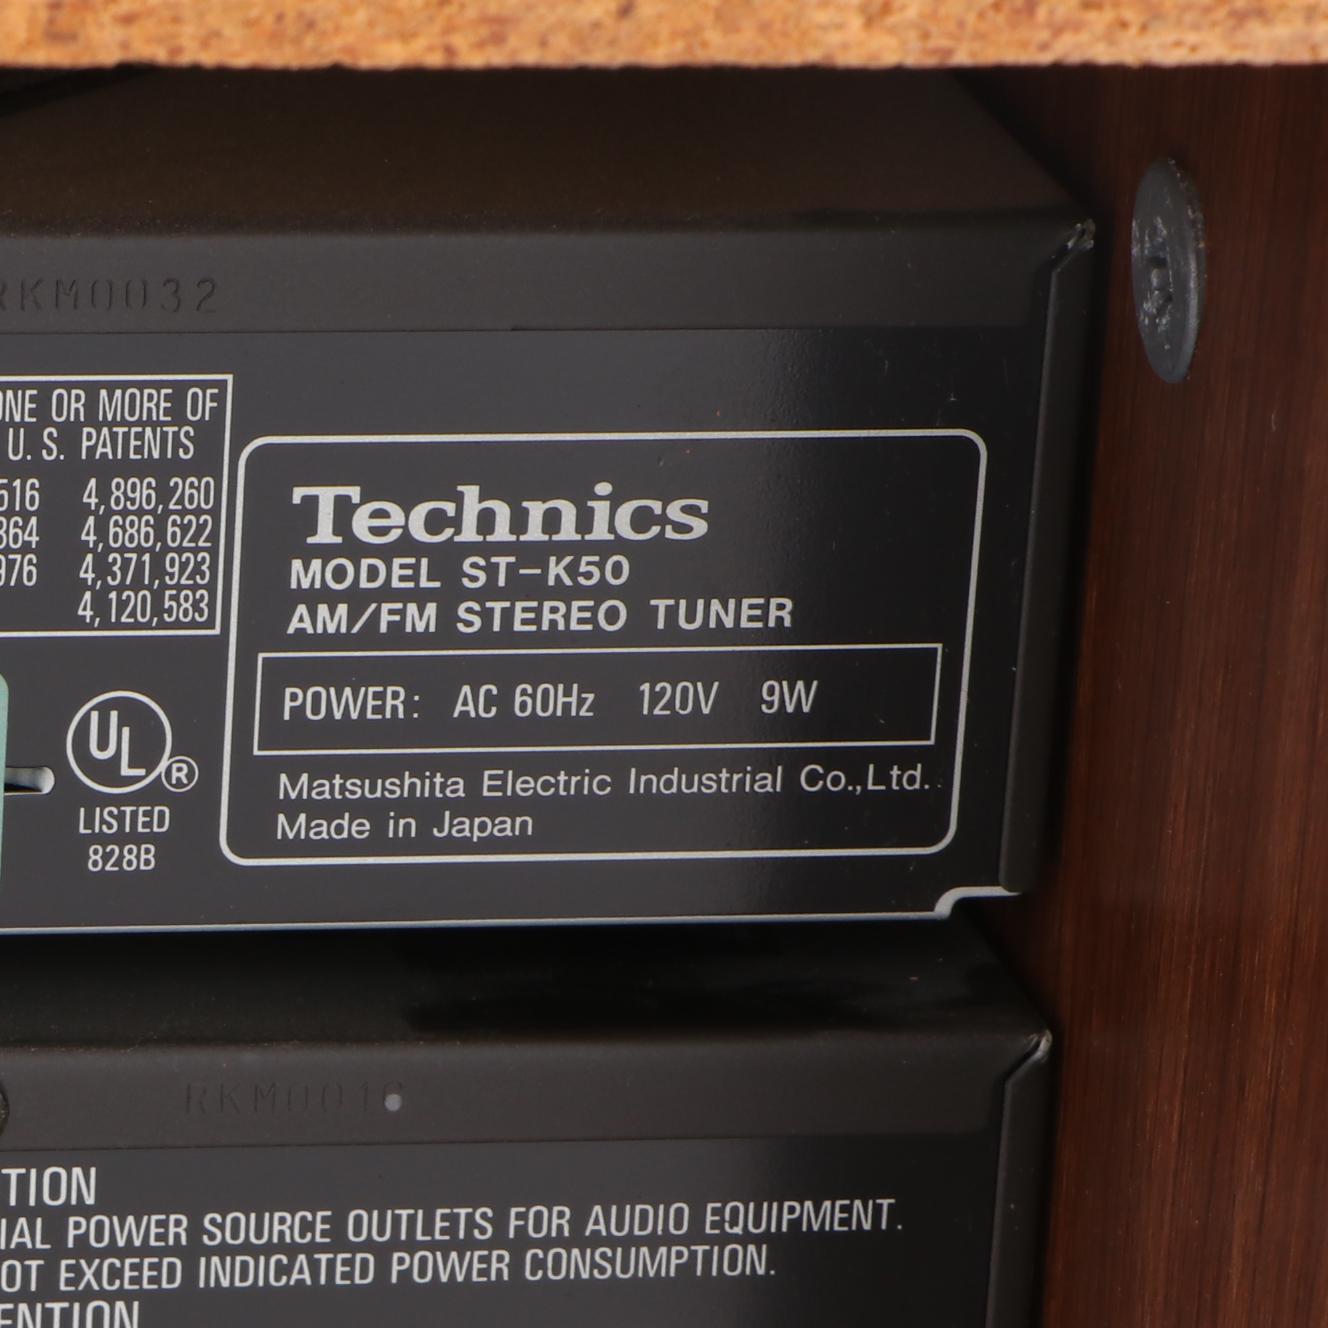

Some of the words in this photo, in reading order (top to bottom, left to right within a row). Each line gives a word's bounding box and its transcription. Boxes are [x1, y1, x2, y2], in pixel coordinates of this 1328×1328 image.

[52, 389, 85, 422] OR
[99, 388, 172, 421] MORE
[187, 387, 218, 421] OF
[82, 426, 194, 459] PATENTS
[83, 477, 214, 515] 4,896,260
[292, 482, 708, 544] Technics
[81, 515, 212, 552] 4,686,622
[79, 552, 210, 589] 4,371,923
[291, 558, 441, 590] MODEL
[462, 555, 629, 588] ST-K50
[78, 589, 208, 627] 4,120,583
[287, 603, 437, 634] AM/FM
[457, 600, 627, 633] STEREO
[650, 598, 792, 630] TUNER
[284, 686, 419, 720] POWER:
[453, 684, 497, 718] AC
[514, 684, 594, 717] 60Hz
[640, 682, 719, 715] 120V
[761, 680, 817, 713] 9W
[279, 771, 465, 799] Matsushita
[483, 769, 611, 796] Electric
[629, 766, 782, 794] Industrial
[79, 806, 169, 834] LISTED
[277, 812, 370, 839] Made
[388, 812, 416, 838] in
[433, 811, 532, 842] Japan
[88, 844, 155, 871] 828B
[68, 1214, 187, 1248] POWER
[203, 1211, 331, 1245] SOURCE
[348, 1207, 493, 1242] OUTLETS
[509, 1206, 570, 1238] FOR
[585, 1203, 689, 1236] AUDIO
[705, 1199, 901, 1235] EQUIPMENT.
[60, 1257, 182, 1291] EXCEED
[199, 1253, 374, 1288] INDICATED
[391, 1250, 509, 1283] POWER
[525, 1244, 774, 1280] CONSUMPTION.
